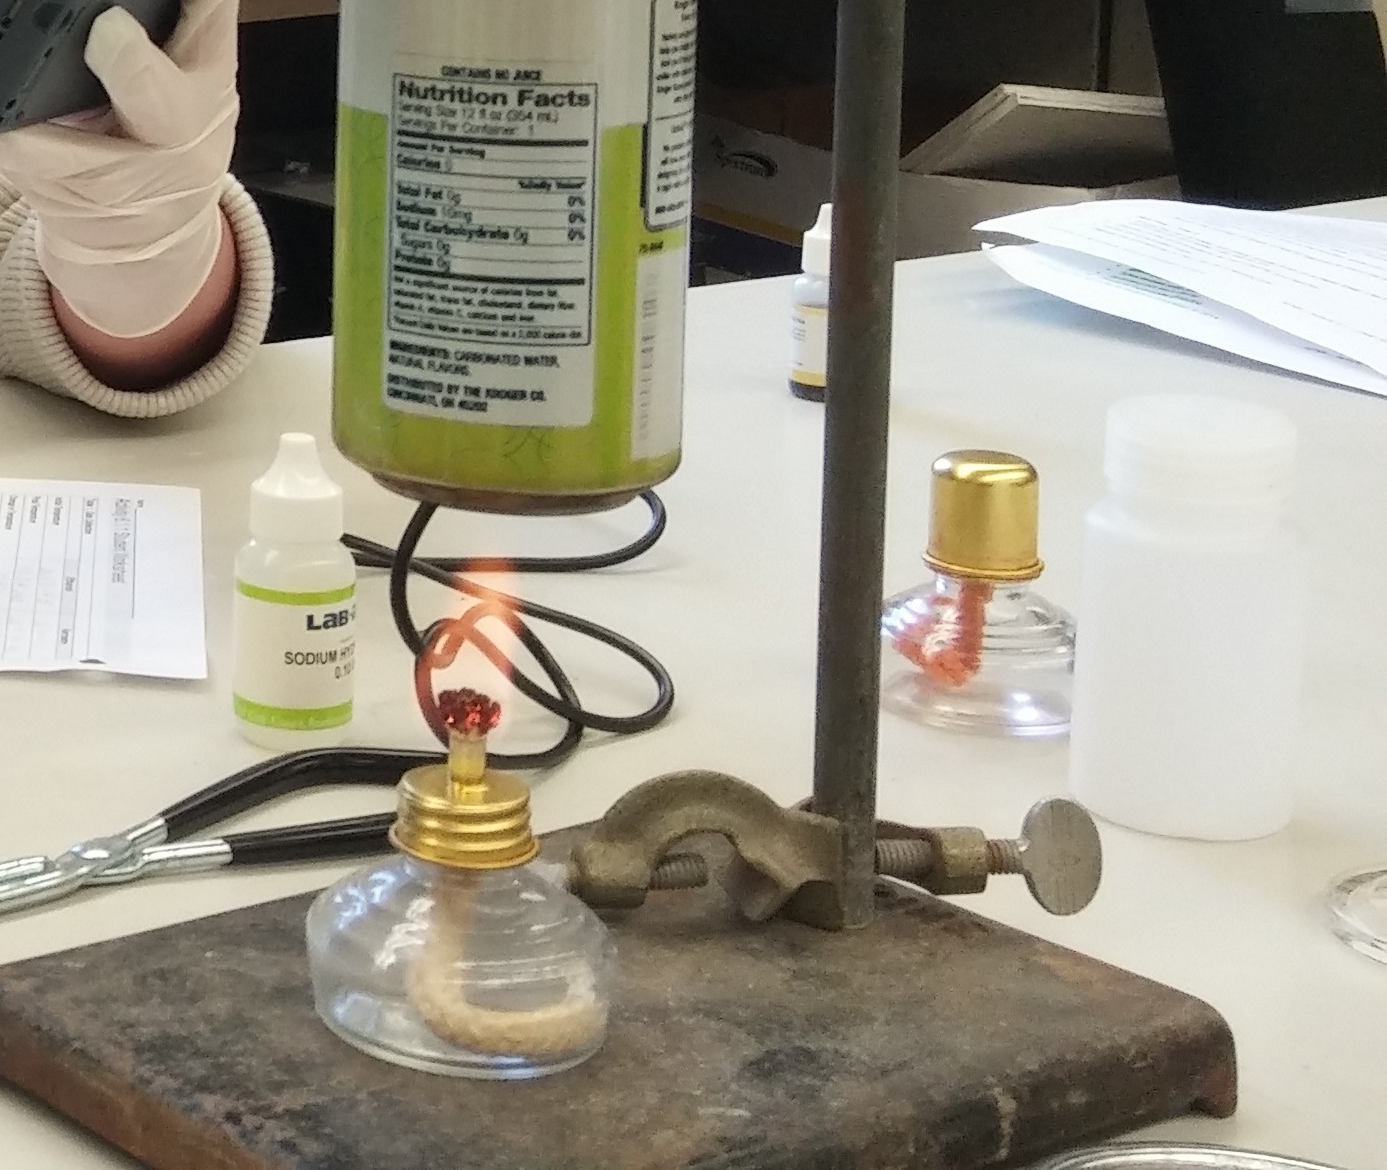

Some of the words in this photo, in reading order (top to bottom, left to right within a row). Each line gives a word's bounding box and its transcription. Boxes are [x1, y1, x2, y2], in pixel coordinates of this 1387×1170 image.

[398, 80, 508, 106] Nutrition
[517, 88, 590, 108] Facts
[424, 187, 444, 201] Fat
[284, 651, 337, 665] SODIUM
